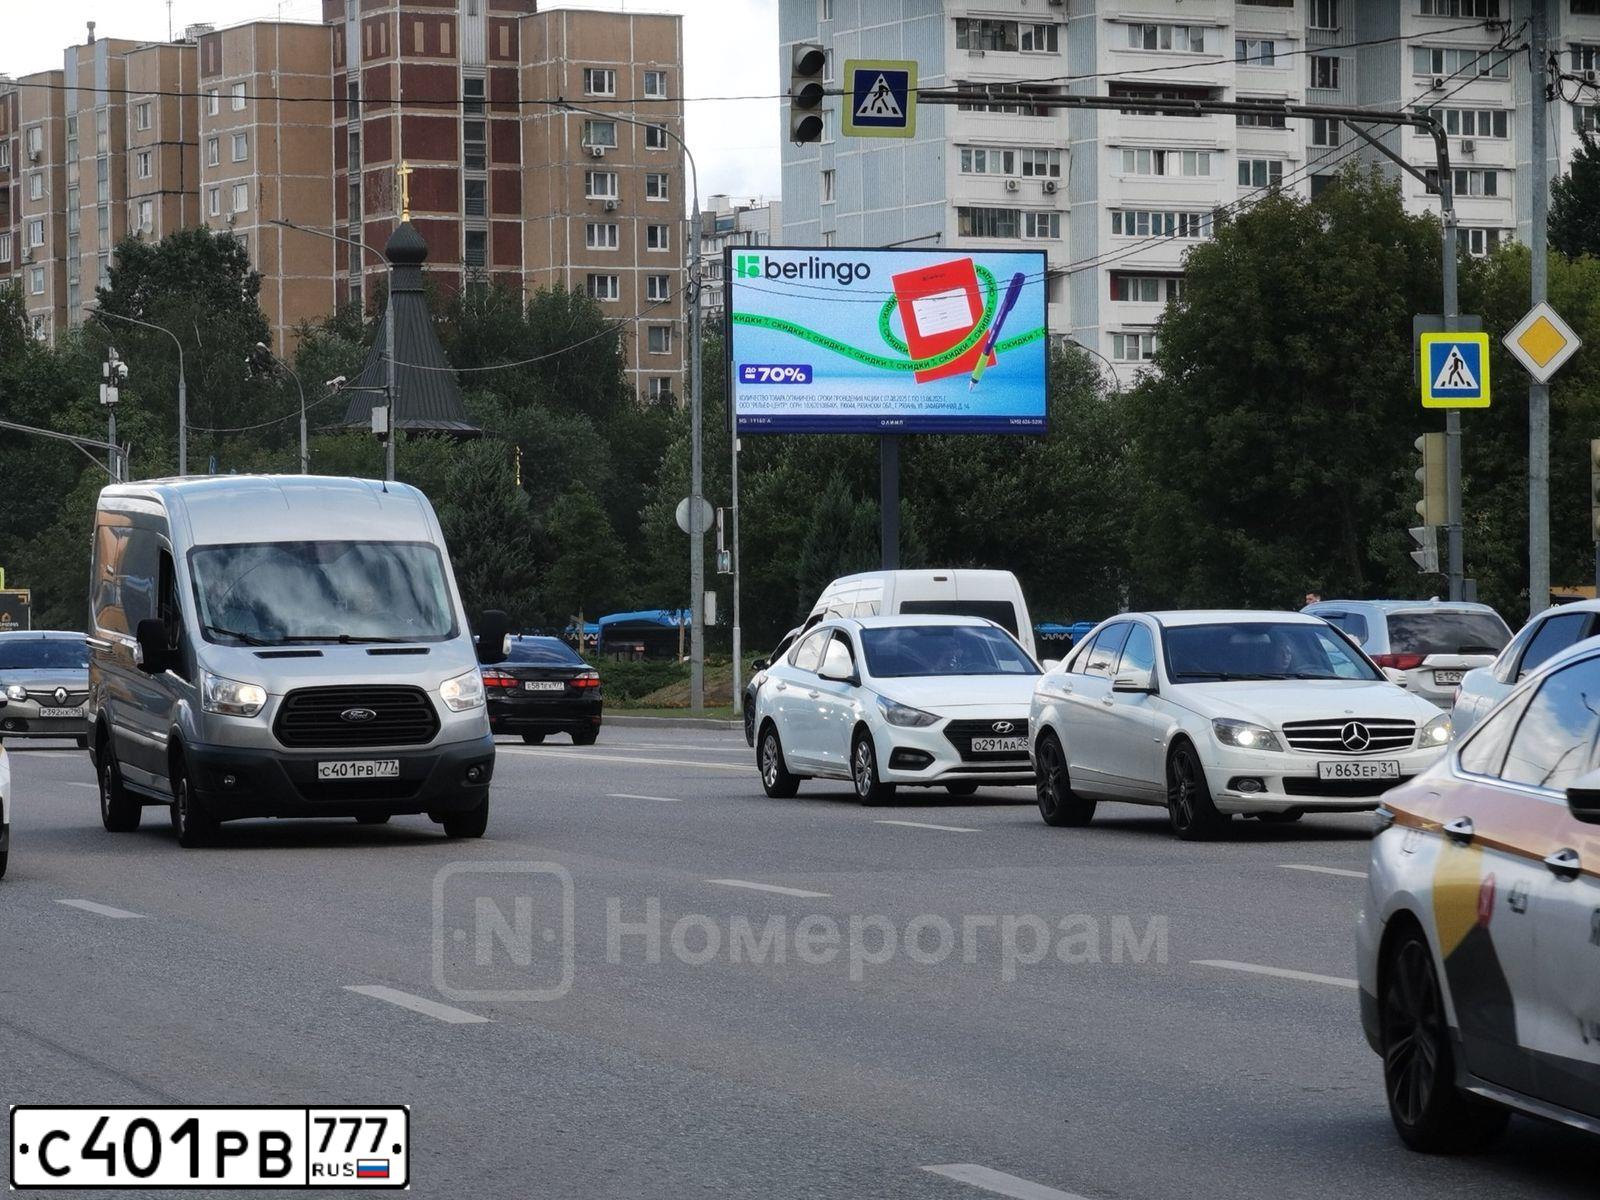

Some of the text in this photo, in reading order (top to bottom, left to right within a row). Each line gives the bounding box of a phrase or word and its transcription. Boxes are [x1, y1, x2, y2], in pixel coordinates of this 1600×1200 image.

[765, 256, 871, 285] berlingo
[771, 321, 804, 337] СКИДКИ
[813, 335, 845, 353] СКИДКИ
[854, 351, 887, 367] СКИДКИ
[896, 360, 930, 371] СКИДКИ
[939, 343, 969, 363] СКИДКИ
[974, 307, 992, 338] СКИДКИ
[1001, 335, 1034, 350] СКИДКИ
[974, 739, 1016, 750] О291АА
[322, 761, 396, 777] С401РВ 777
[1325, 762, 1394, 777] У863ЕР 31
